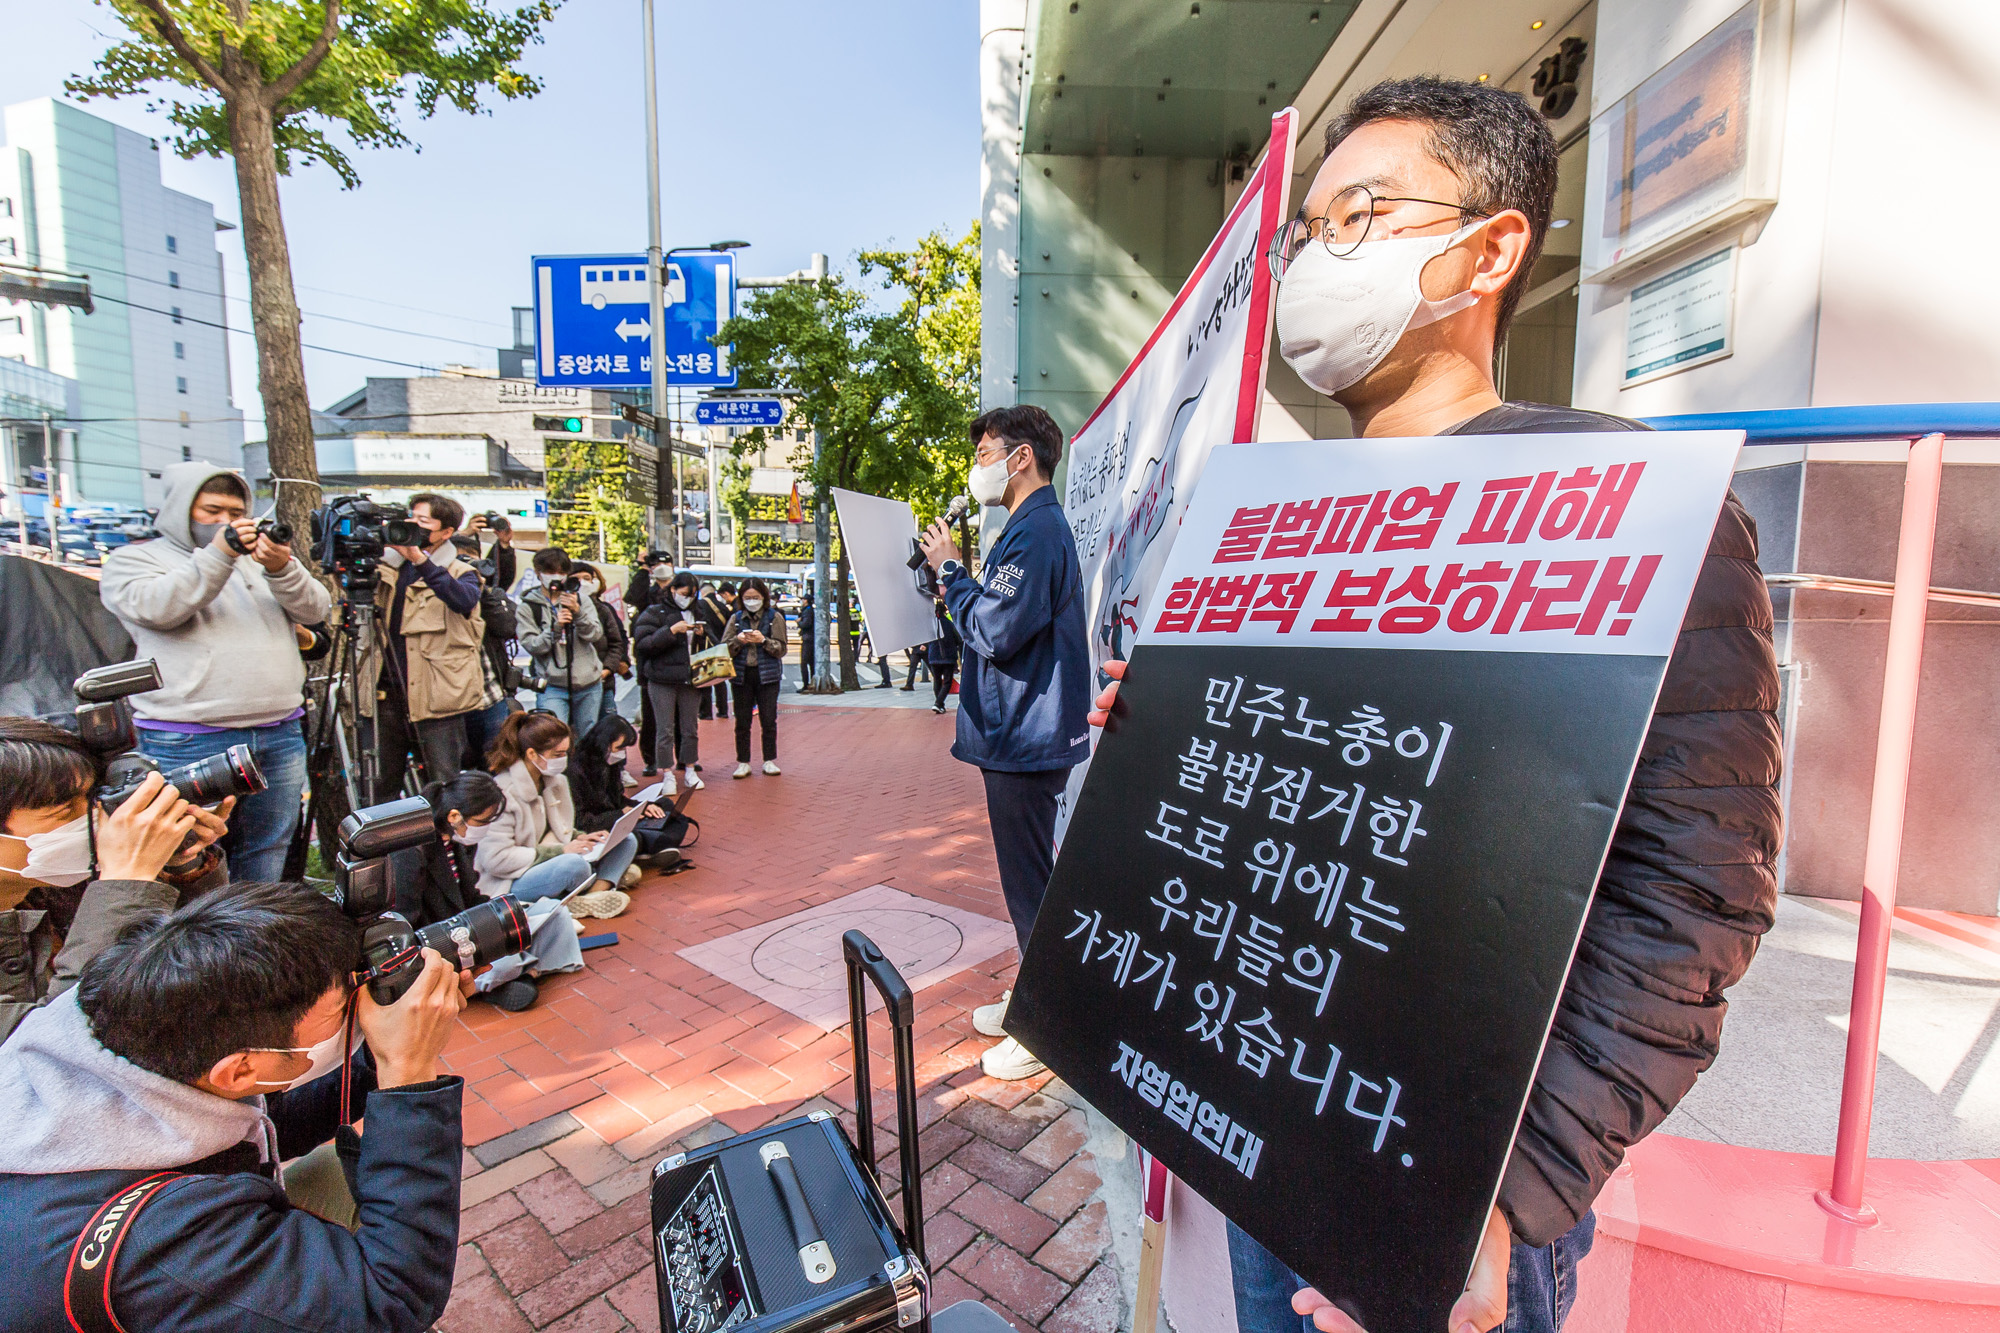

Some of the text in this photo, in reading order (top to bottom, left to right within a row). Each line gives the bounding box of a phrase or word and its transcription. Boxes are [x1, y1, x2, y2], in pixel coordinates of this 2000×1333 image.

[557, 354, 630, 375] 중앙차로
[717, 402, 761, 415] 새문안로
[699, 408, 710, 419] 32
[713, 416, 765, 424] Saemunan-ro
[768, 408, 780, 418] 36
[1213, 482, 1460, 563] 불법파업
[1457, 462, 1646, 544] 피해
[1154, 555, 1662, 635] 합법적 보상하라!
[1205, 676, 1453, 787] 민주노총이
[1179, 736, 1428, 867] 불법점거한
[1145, 801, 1405, 952] 도로 위에는
[1151, 877, 1341, 1016] 우리들의
[1065, 910, 1414, 1167] 가게가 있습니다.
[1111, 1042, 1264, 1179] 자영업연대
[81, 1181, 161, 1270] Canon
